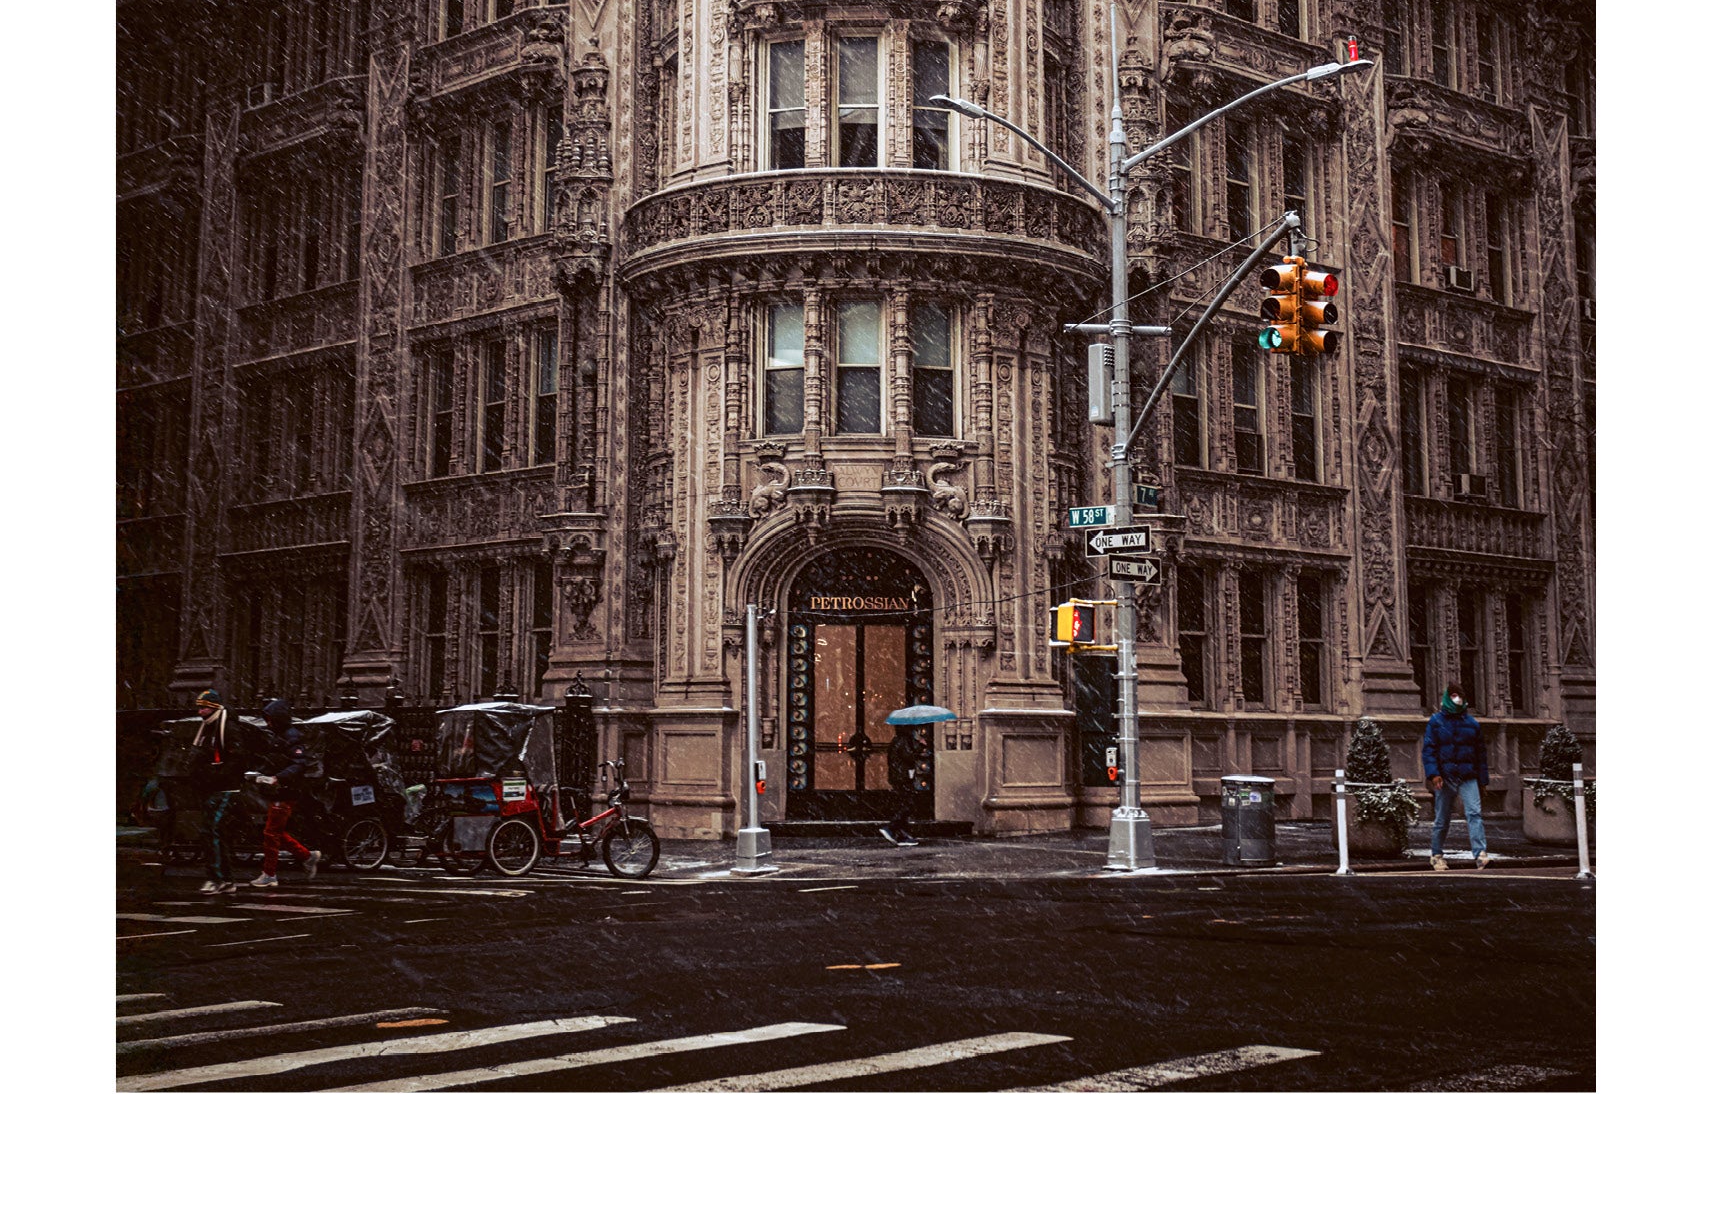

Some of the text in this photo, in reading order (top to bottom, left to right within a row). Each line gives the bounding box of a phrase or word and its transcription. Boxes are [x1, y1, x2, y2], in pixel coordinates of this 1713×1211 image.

[1140, 487, 1146, 502] 7
[1071, 508, 1104, 524] W 58 ST
[1095, 534, 1142, 548] ONE WAY
[1115, 562, 1153, 576] ONE WAY
[810, 596, 910, 610] PETROSSIAN
